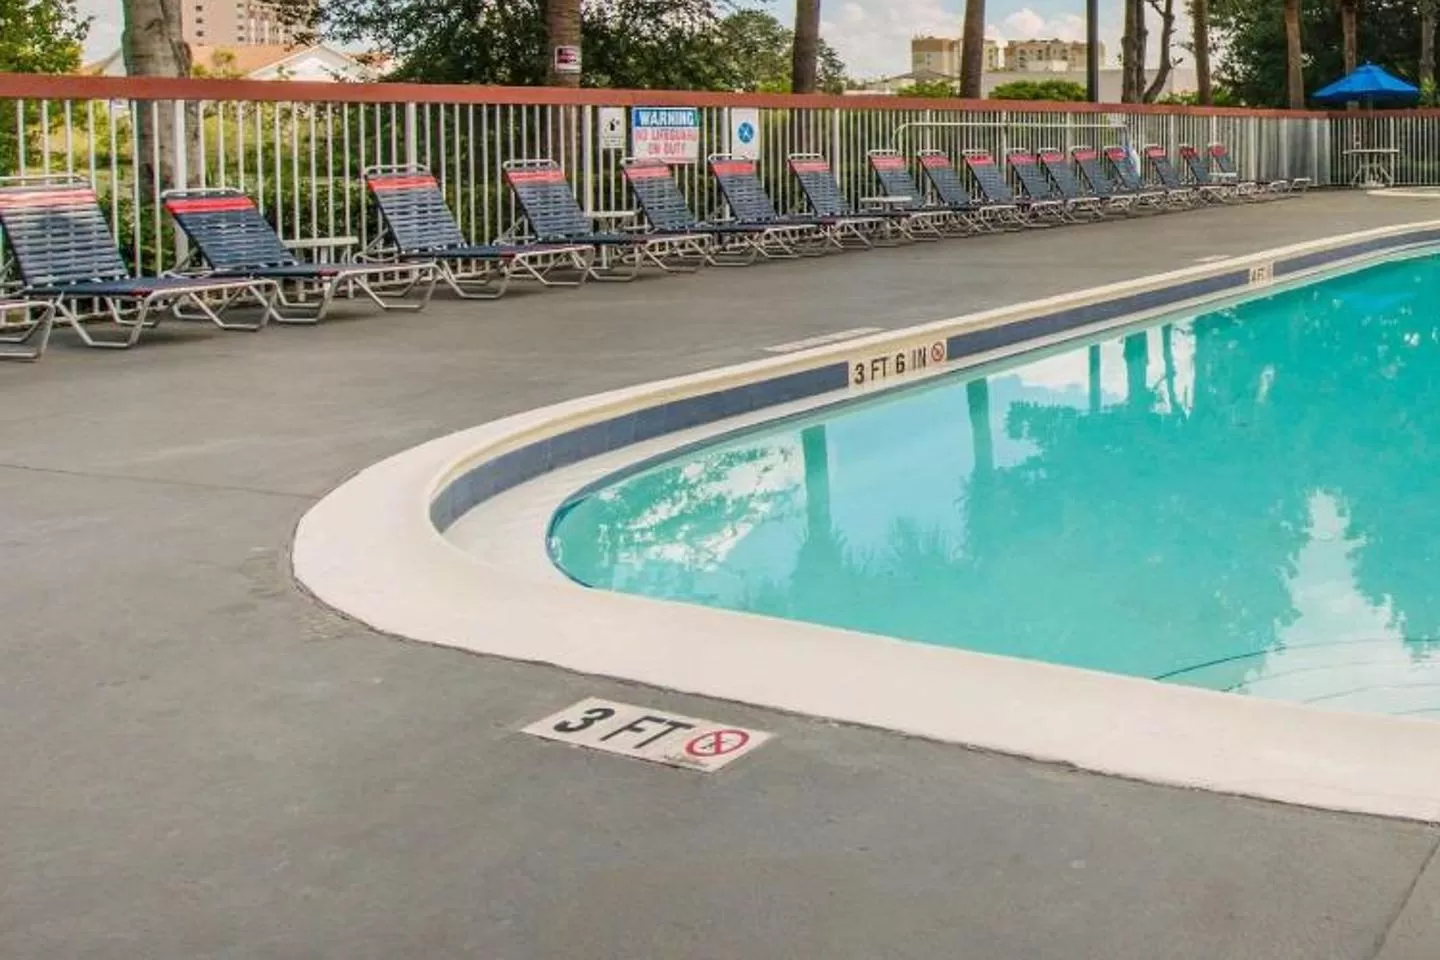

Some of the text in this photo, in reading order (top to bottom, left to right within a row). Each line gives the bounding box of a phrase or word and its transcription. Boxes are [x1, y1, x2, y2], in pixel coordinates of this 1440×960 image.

[639, 110, 694, 126] WARNING
[854, 347, 927, 385] 3 FT 6 IN
[553, 707, 696, 750] 3 FT
